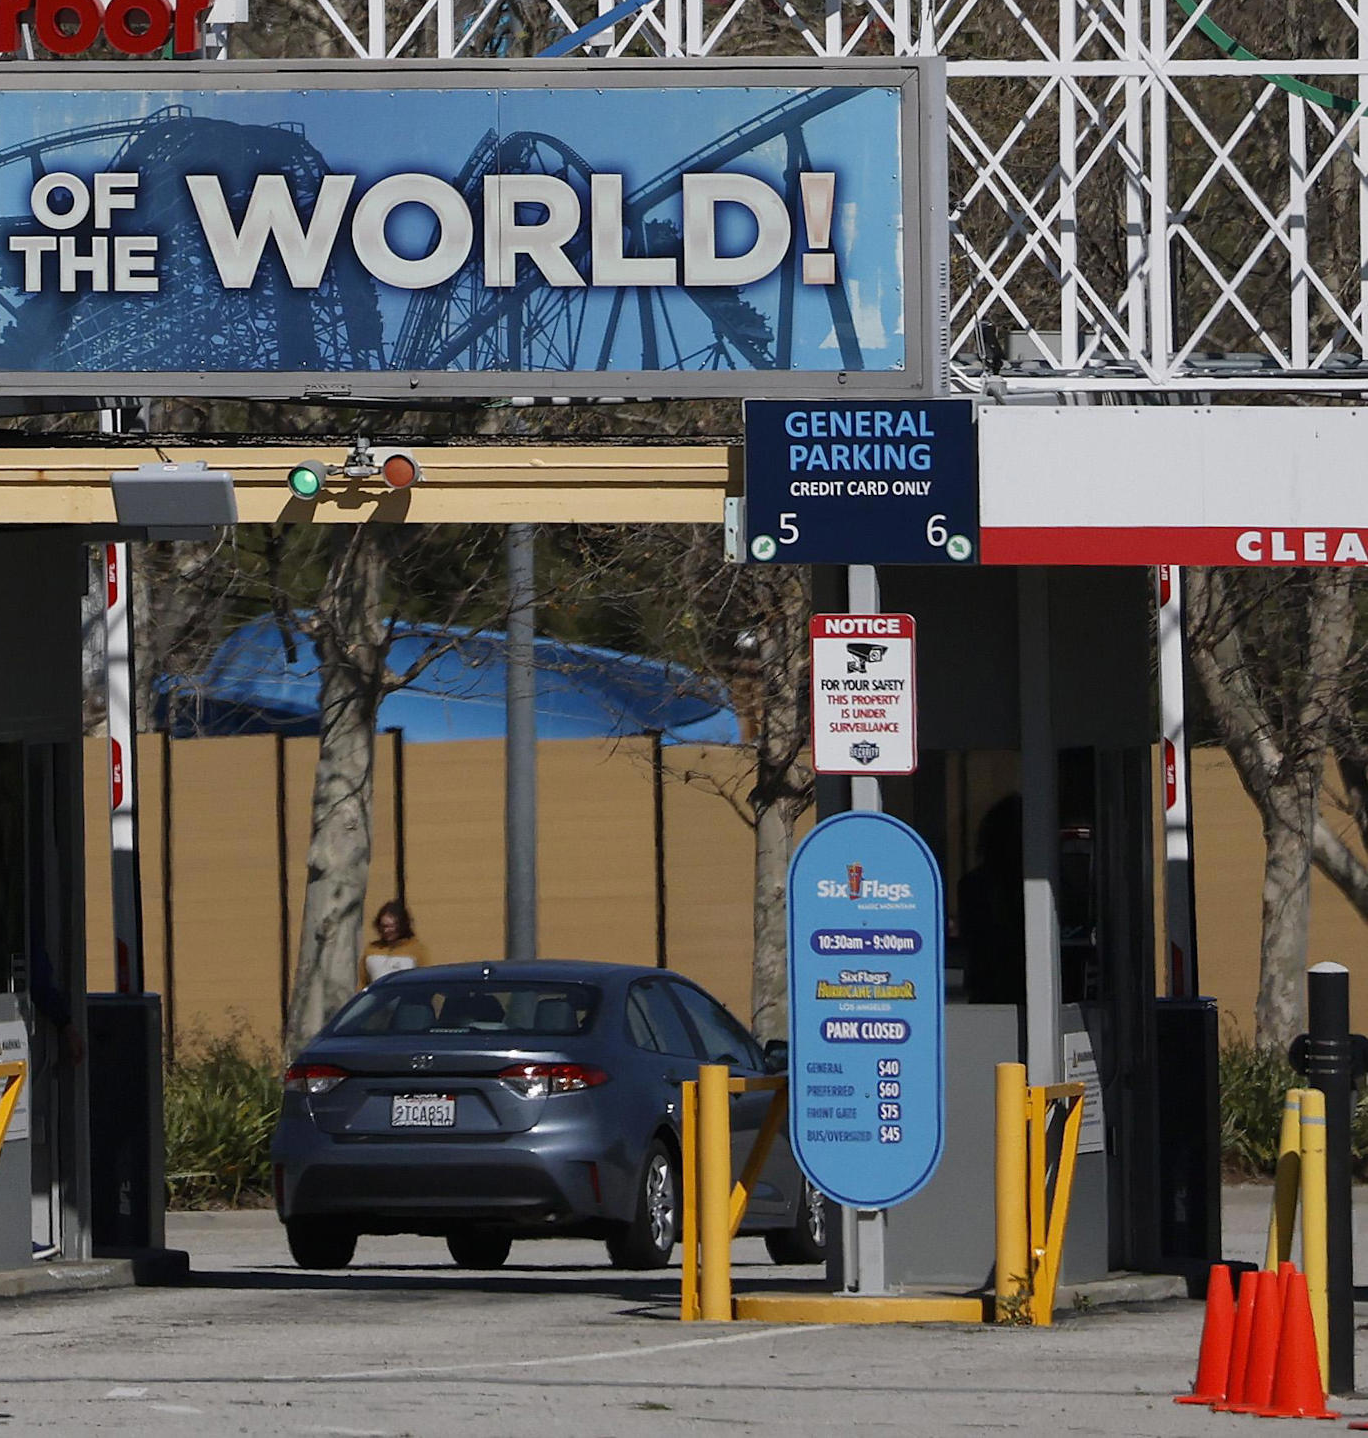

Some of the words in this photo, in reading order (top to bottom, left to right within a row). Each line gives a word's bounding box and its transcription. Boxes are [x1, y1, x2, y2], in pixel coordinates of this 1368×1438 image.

[31, 172, 138, 231] OF
[186, 171, 837, 290] WORLD!
[9, 235, 160, 292] THE
[785, 410, 935, 438] GENERAL
[789, 444, 932, 472] PARKING
[790, 481, 844, 497] CREDIT
[846, 481, 889, 496] CARD
[892, 481, 932, 496] ONLY
[779, 512, 800, 545] 5
[926, 514, 948, 547] 6
[825, 618, 901, 634] NOTICE
[821, 679, 840, 691] FOR
[842, 679, 869, 691] YOUR
[872, 679, 905, 691] SAFETY
[827, 695, 848, 705] THIS
[852, 695, 901, 706] PROPERTY
[841, 709, 850, 719] IS
[852, 708, 886, 719] UNDER
[829, 722, 899, 733] SURVEILLANCE
[817, 880, 848, 898] Six
[862, 879, 912, 901] Flags
[818, 935, 863, 950] 10:30am
[873, 935, 915, 952] 9:00pm
[826, 1022, 860, 1039] PARK
[861, 1022, 905, 1040] CLOSED
[807, 1063, 843, 1074] GENERAL
[878, 1060, 900, 1076] $40
[879, 1083, 899, 1098] $60
[880, 1104, 899, 1120] $75
[880, 1126, 900, 1143] $45
